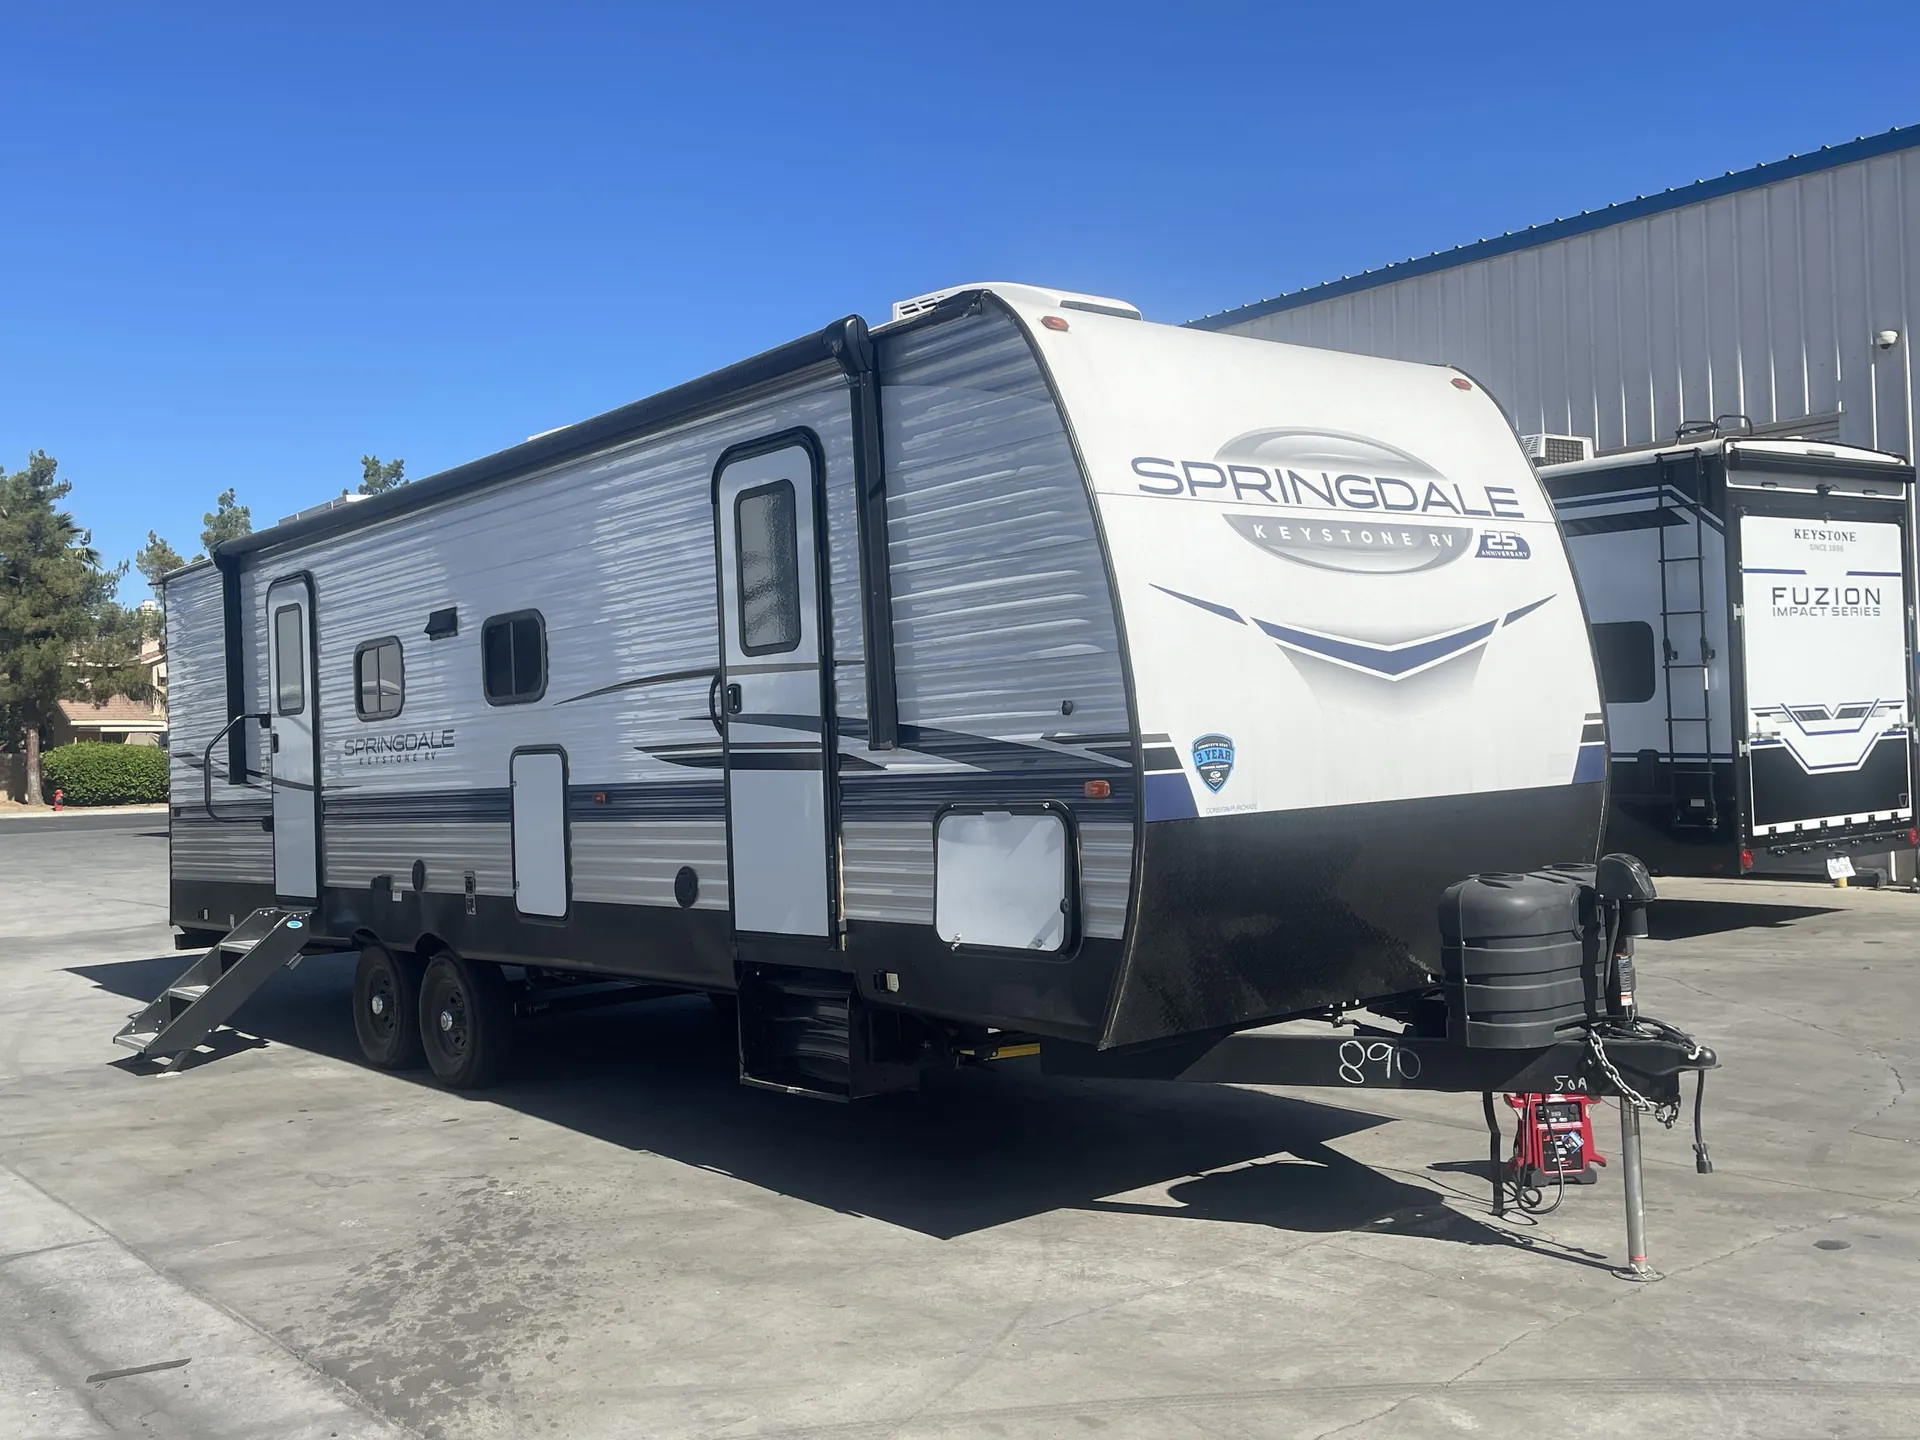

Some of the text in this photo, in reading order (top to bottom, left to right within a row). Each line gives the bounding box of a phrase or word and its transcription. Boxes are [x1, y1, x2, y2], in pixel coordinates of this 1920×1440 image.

[1130, 456, 1525, 518] SPRINGDALE
[1252, 524, 1453, 547] KEYSTONE RV
[1484, 530, 1518, 550] 25
[1793, 528, 1857, 542] KEYSTONE
[1481, 549, 1528, 558] ANNIVERSARY
[1809, 543, 1828, 552] SINCE
[1772, 587, 1881, 605] FUZION
[1772, 606, 1881, 617] IMPACT SERIES
[344, 729, 455, 757] SPRINGDALE
[359, 751, 437, 765] KEYSTONE RV
[1196, 749, 1231, 764] 3 YEAR
[1338, 1040, 1421, 1084] 890
